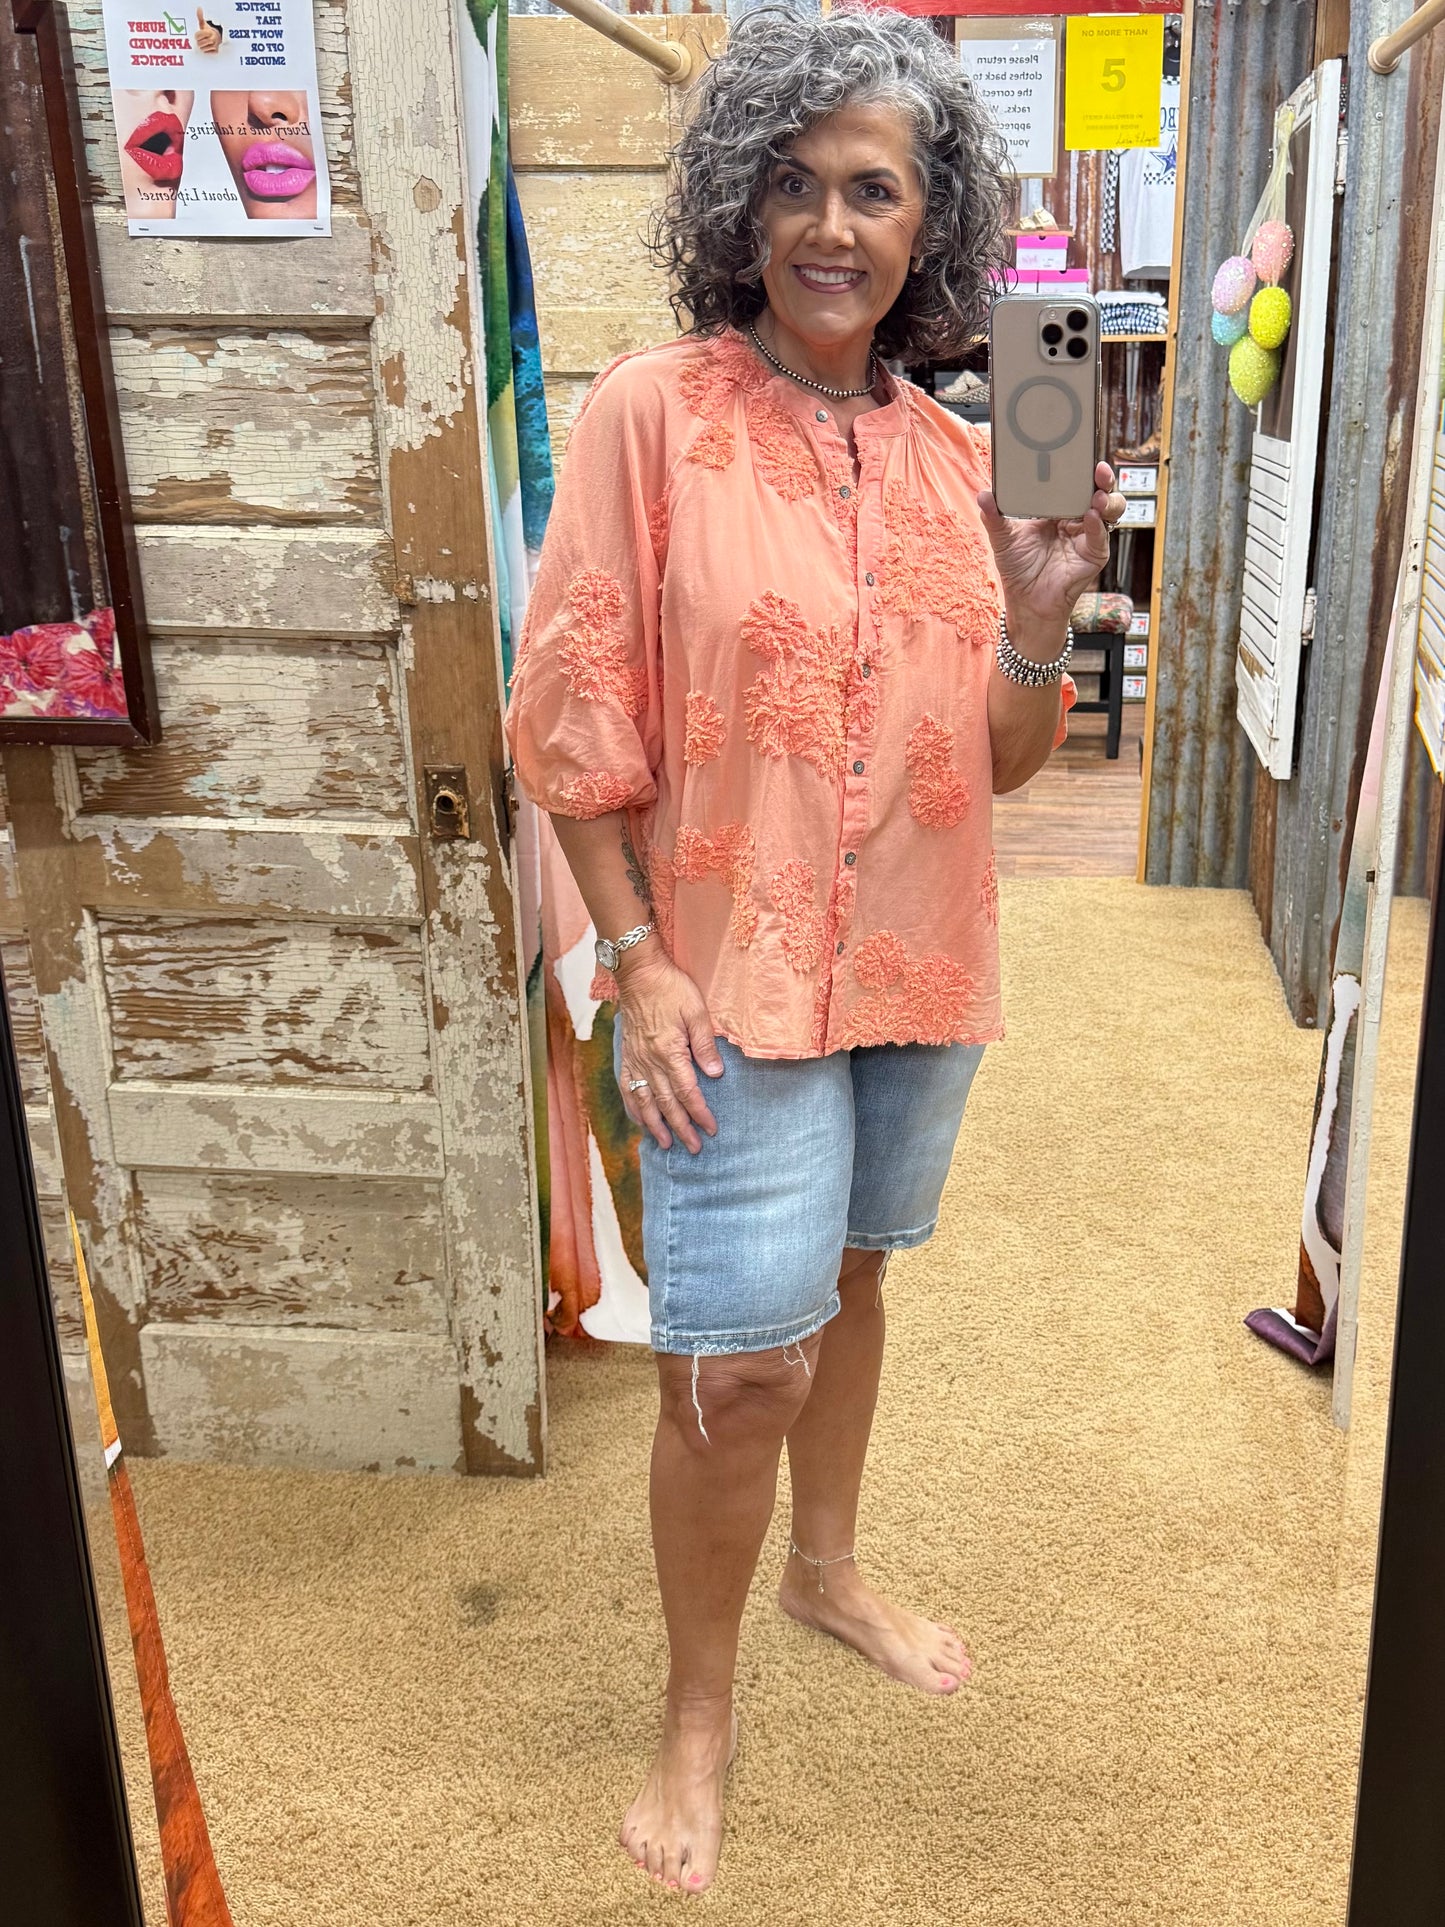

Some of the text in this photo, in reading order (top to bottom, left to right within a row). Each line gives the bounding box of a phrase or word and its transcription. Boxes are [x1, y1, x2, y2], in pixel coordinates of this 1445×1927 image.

[1081, 28, 1148, 37] NO MORE THAN
[1101, 58, 1126, 92] 5
